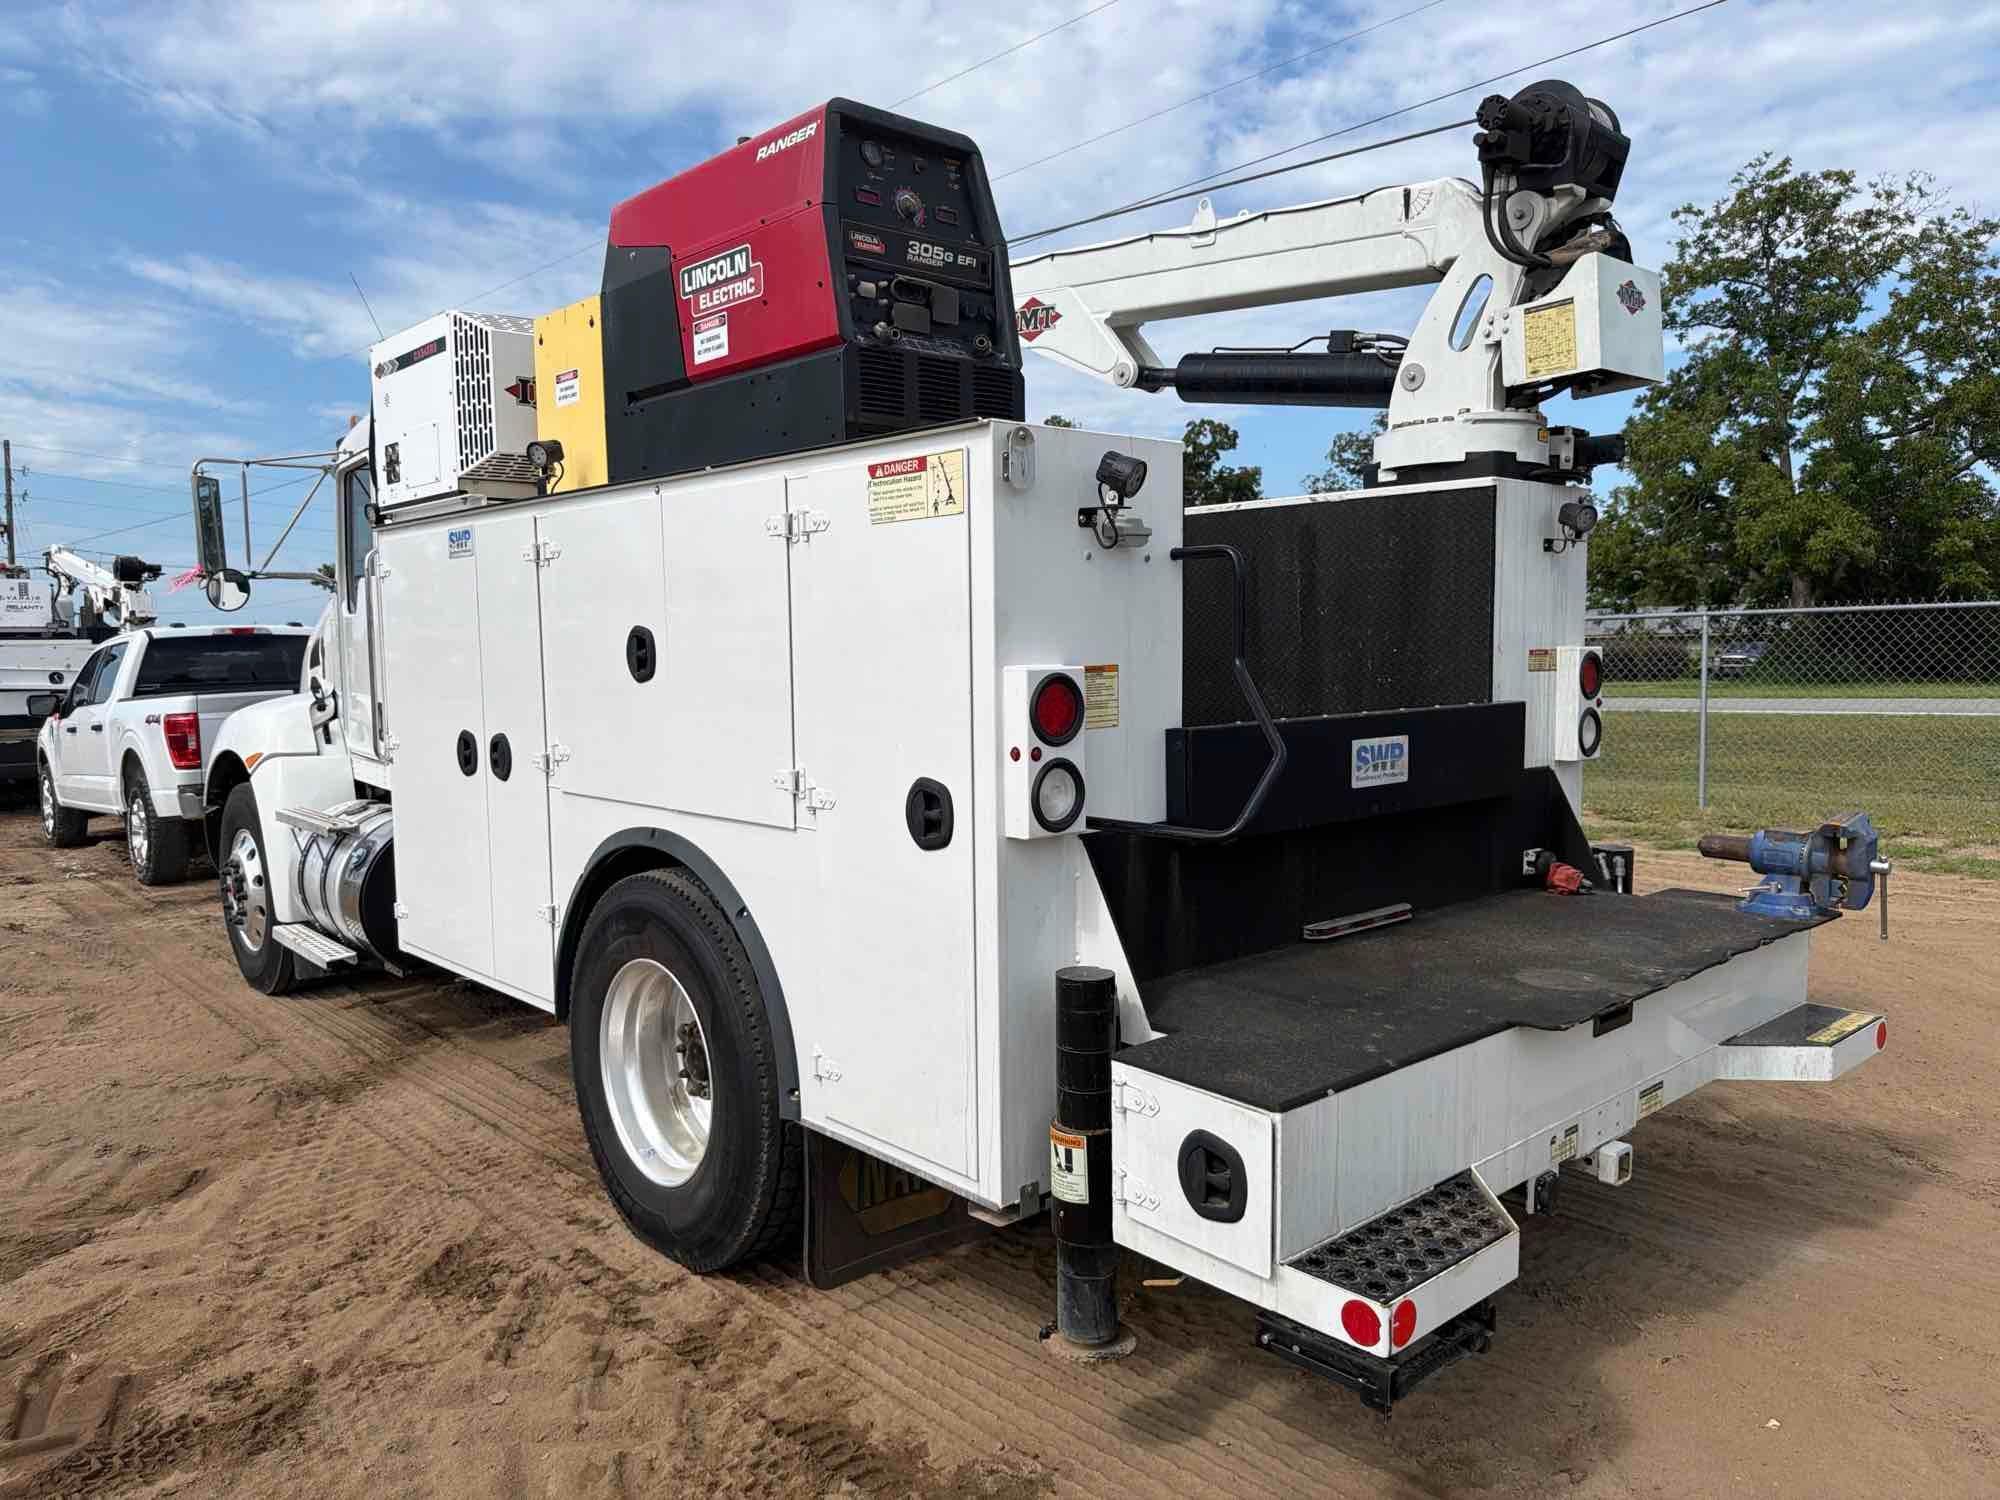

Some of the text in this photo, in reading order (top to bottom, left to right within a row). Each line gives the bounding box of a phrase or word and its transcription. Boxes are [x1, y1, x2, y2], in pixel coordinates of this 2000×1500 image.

[756, 122, 817, 162] RANGER
[850, 230, 880, 244] LINCOLN
[684, 252, 747, 292] LINCOLN
[907, 254, 944, 267] RANGER
[957, 255, 977, 268] EFI
[699, 277, 756, 310] ELECTRIC
[1016, 306, 1056, 332] MT
[884, 460, 919, 475] DANGER
[1356, 743, 1404, 768] SWP
